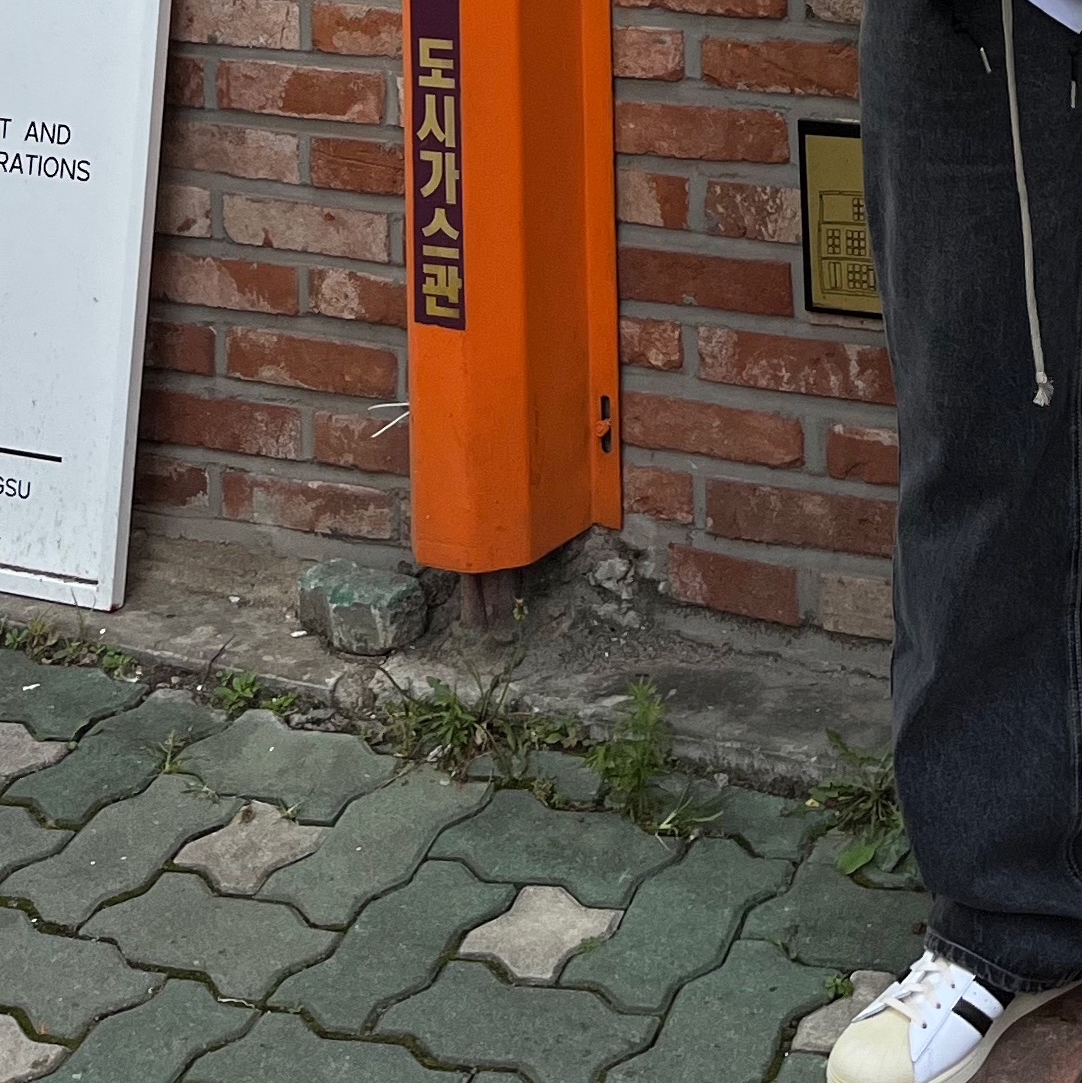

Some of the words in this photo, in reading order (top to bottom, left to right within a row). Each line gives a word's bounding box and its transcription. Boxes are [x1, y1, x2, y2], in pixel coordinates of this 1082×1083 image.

[24, 120, 71, 145] AND
[0, 150, 90, 182] RATIONS
[416, 37, 463, 319] 도시가스관
